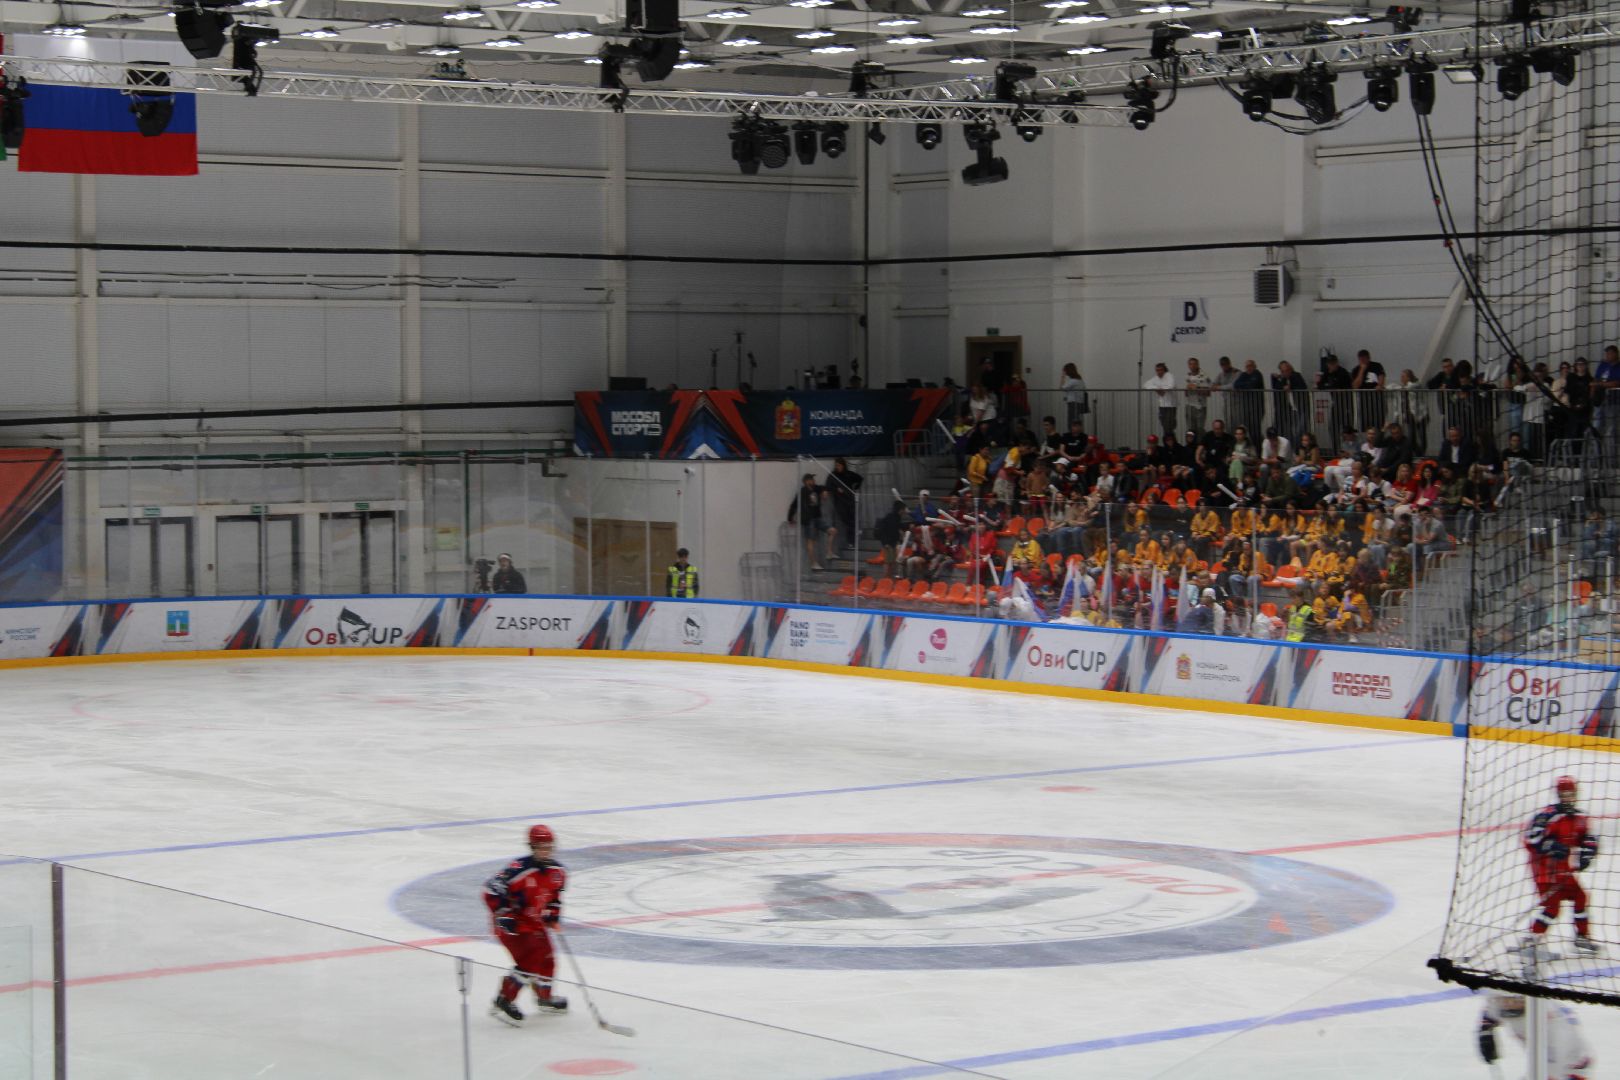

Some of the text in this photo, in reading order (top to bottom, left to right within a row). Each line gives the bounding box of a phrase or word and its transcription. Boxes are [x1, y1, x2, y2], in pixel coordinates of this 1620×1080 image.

[1183, 301, 1197, 321] D
[1175, 326, 1206, 335] СЕКТОР
[809, 410, 864, 420] КОМАНДА
[809, 426, 884, 436] ГУБЕРНАТОРА
[496, 616, 572, 631] ZASPORT
[1507, 697, 1561, 725] CUP
